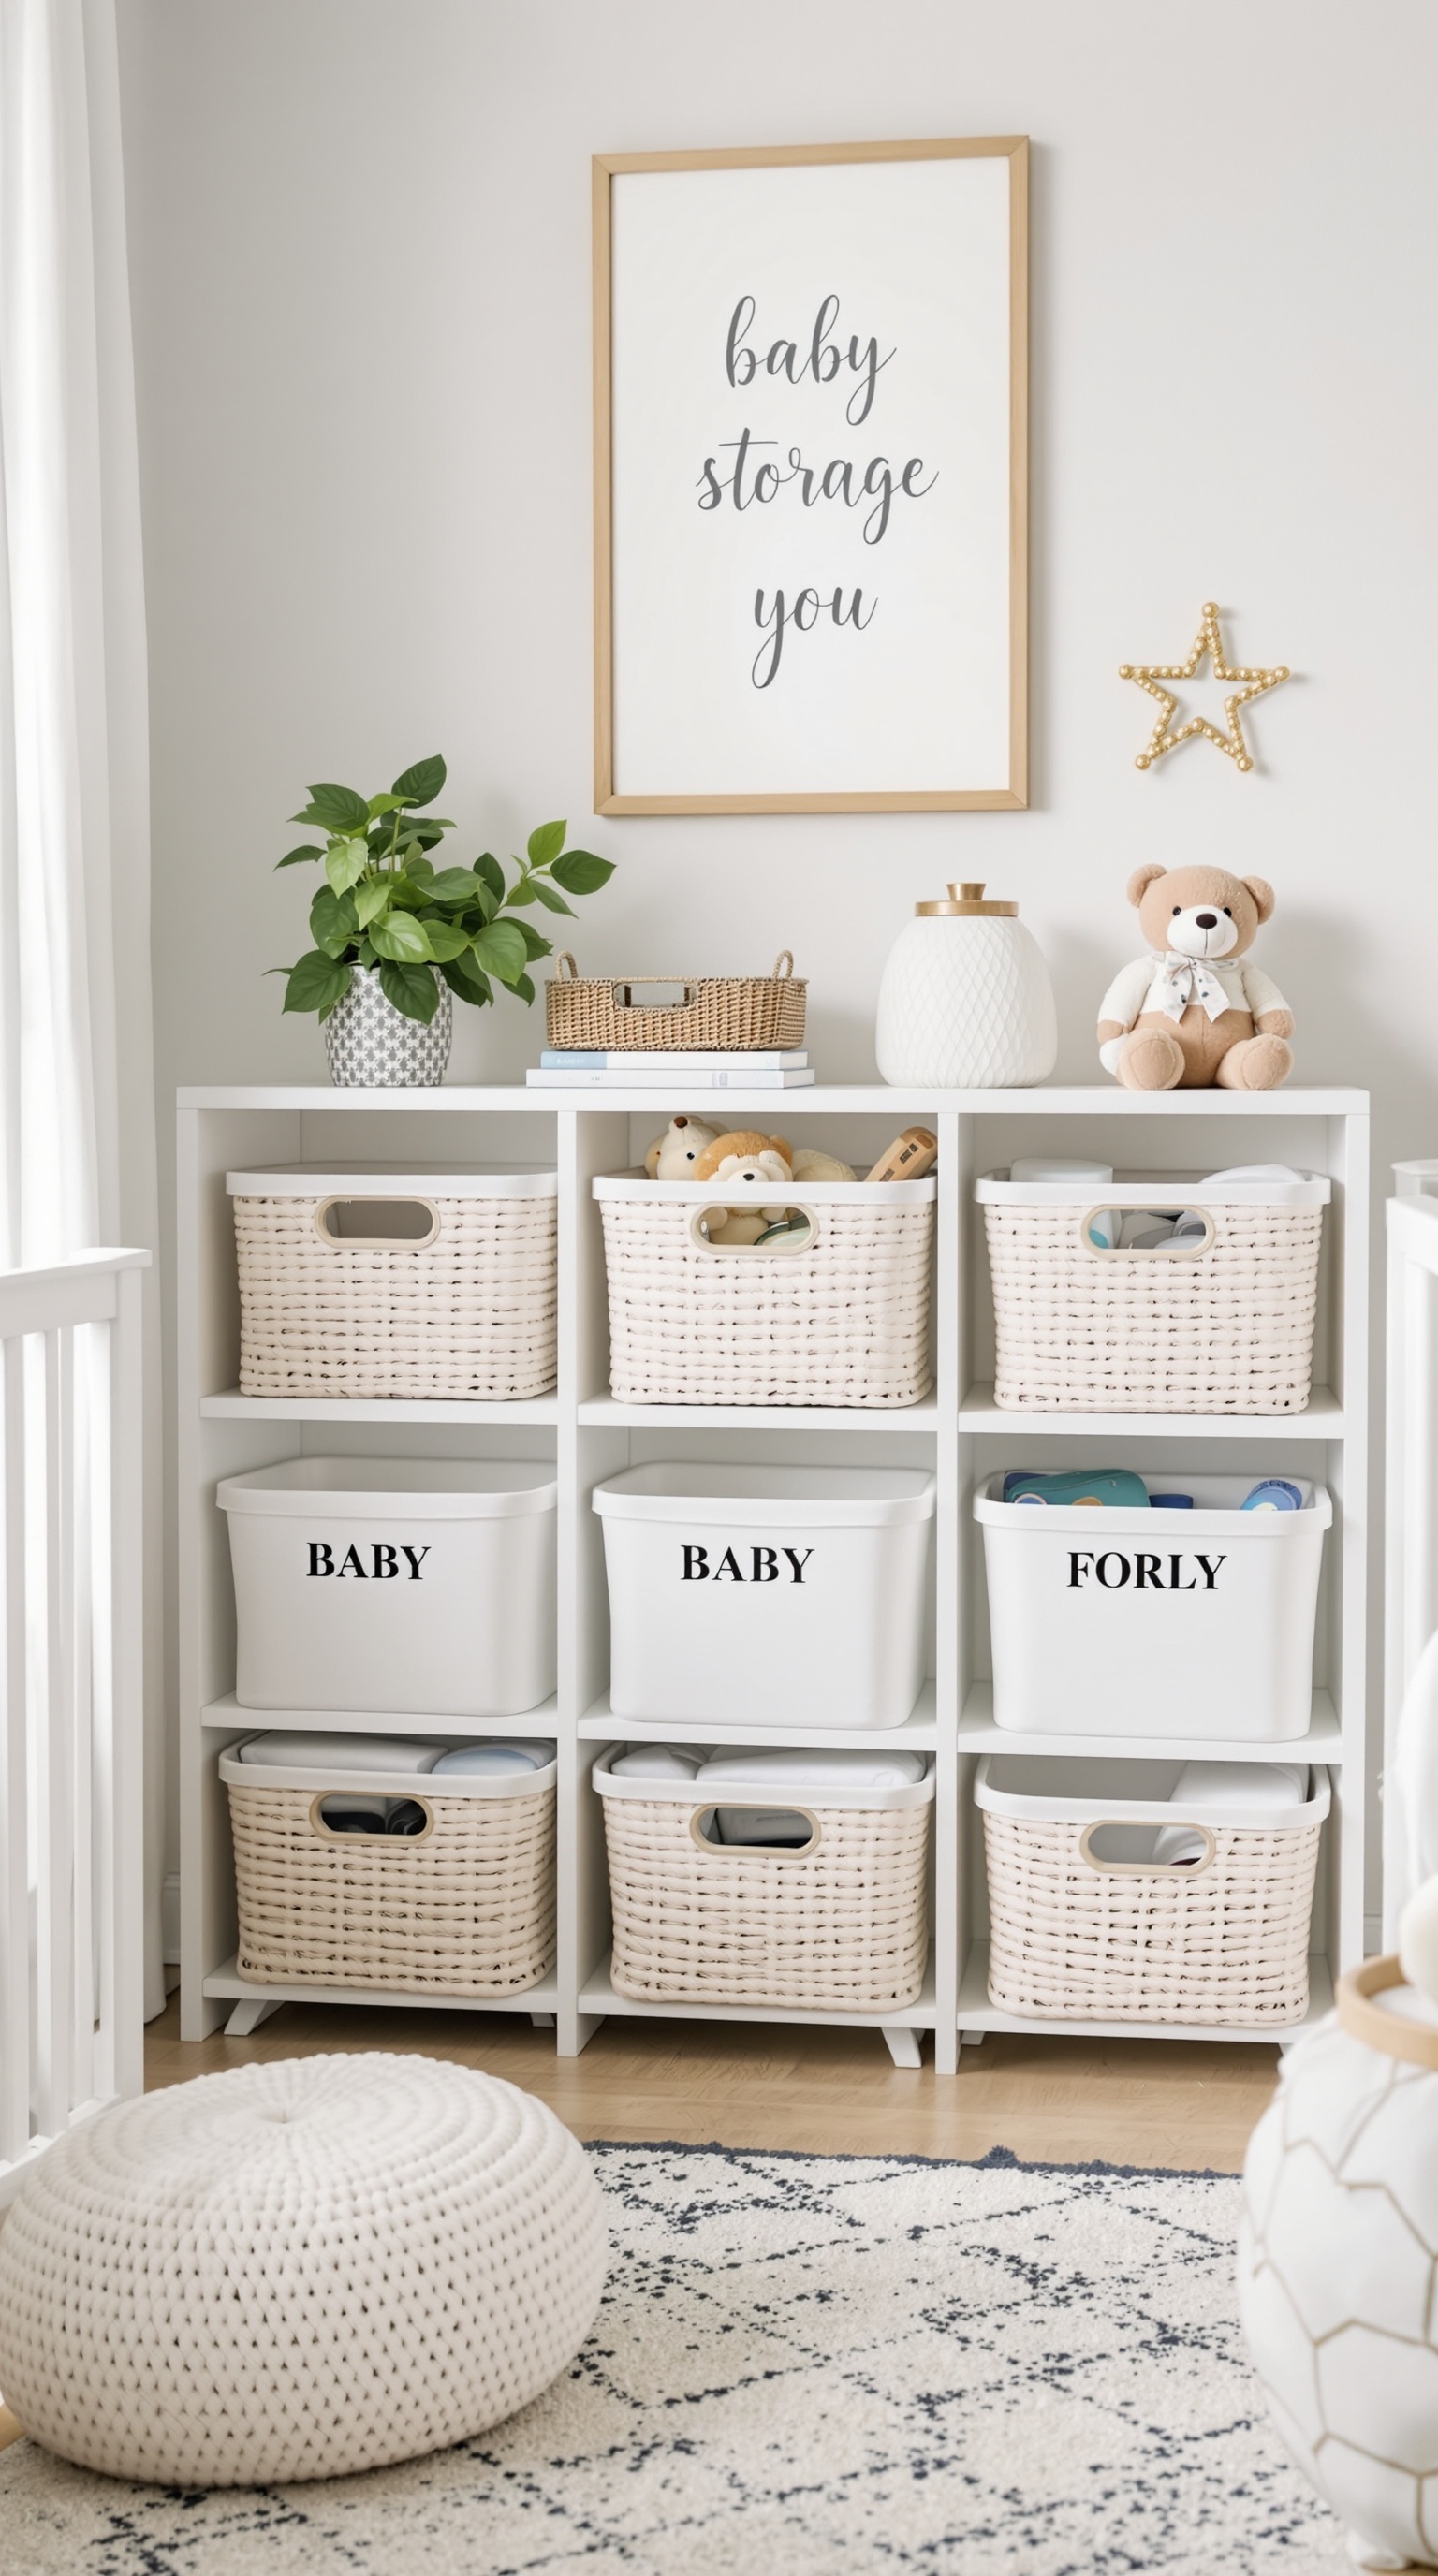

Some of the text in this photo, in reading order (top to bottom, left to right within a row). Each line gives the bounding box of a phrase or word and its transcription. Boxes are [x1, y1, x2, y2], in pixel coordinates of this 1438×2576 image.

[726, 294, 897, 426] baby
[696, 428, 939, 545] storage
[752, 587, 878, 689] you
[306, 1543, 432, 1580] BABY
[681, 1544, 814, 1584] BABY
[1067, 1551, 1227, 1590] FORLY
